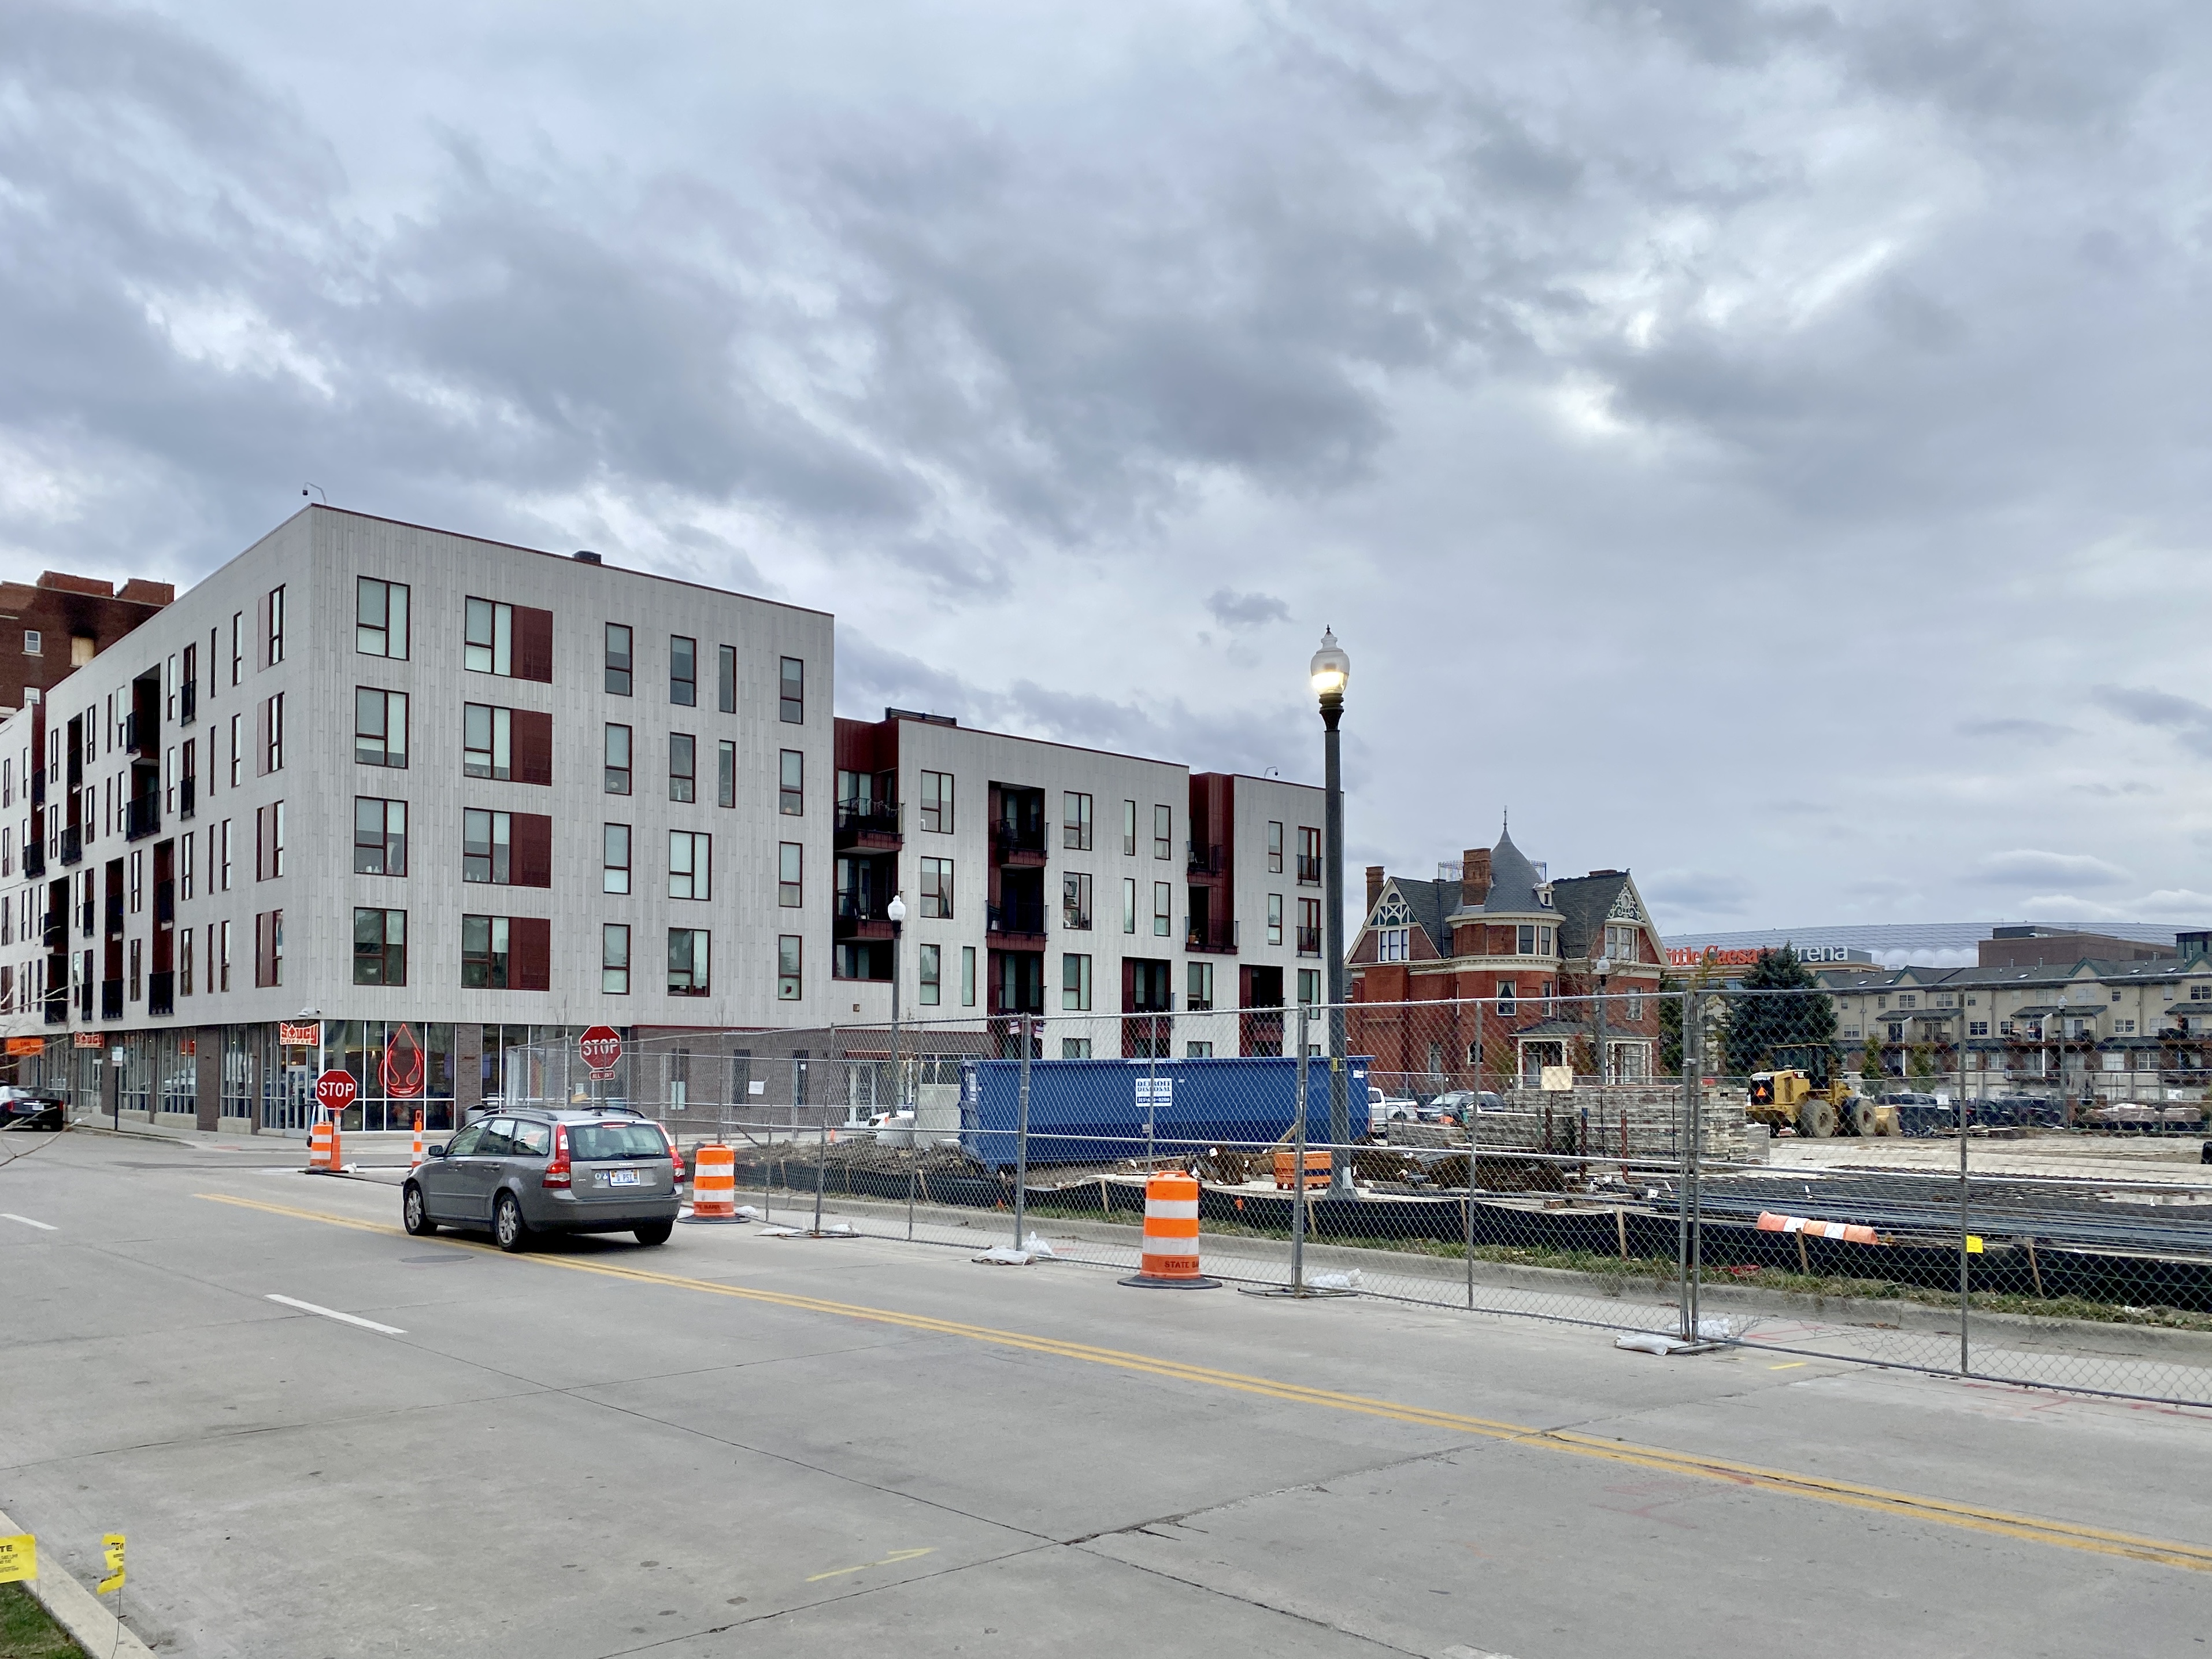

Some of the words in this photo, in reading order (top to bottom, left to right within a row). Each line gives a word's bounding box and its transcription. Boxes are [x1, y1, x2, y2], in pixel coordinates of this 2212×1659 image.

[1666, 947, 1702, 965] ittle
[1703, 945, 1778, 965] Caesa
[1791, 946, 1848, 962] rena
[281, 1024, 317, 1044] SAUCY
[583, 1038, 618, 1056] STOP
[318, 1082, 354, 1097] STOP
[0, 1545, 13, 1553] TE
